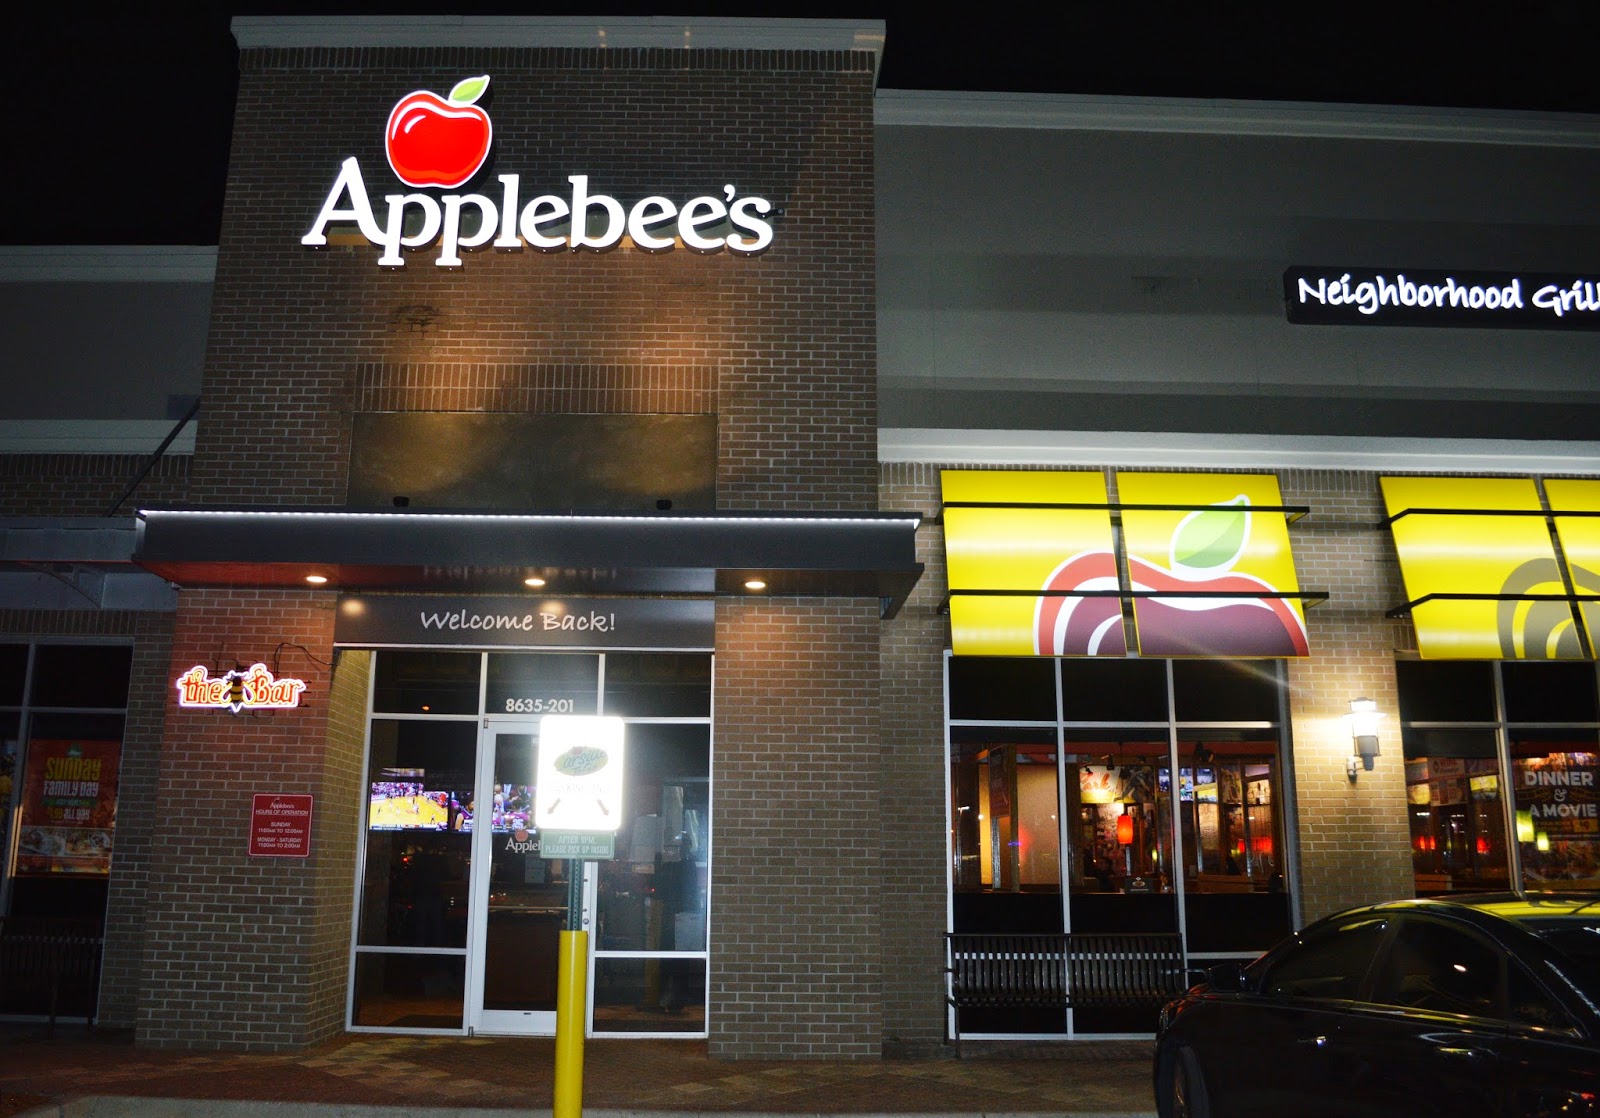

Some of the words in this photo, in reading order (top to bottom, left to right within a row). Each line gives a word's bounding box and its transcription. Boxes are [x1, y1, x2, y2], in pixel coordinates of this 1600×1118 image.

[301, 156, 774, 266] Applebee's
[1298, 273, 1525, 315] Neighborhood
[421, 609, 533, 631] Welcome
[540, 611, 615, 632] Back!
[180, 667, 223, 704] the
[247, 665, 304, 705] Bar
[505, 698, 574, 713] 8635-201
[1525, 771, 1594, 787] DINNER
[1553, 788, 1568, 802] &
[1530, 803, 1540, 817] A
[1542, 803, 1598, 818] MOVIE
[557, 835, 578, 844] AFTER
[545, 844, 566, 854] PLEASE
[590, 846, 609, 854] INSIDE
